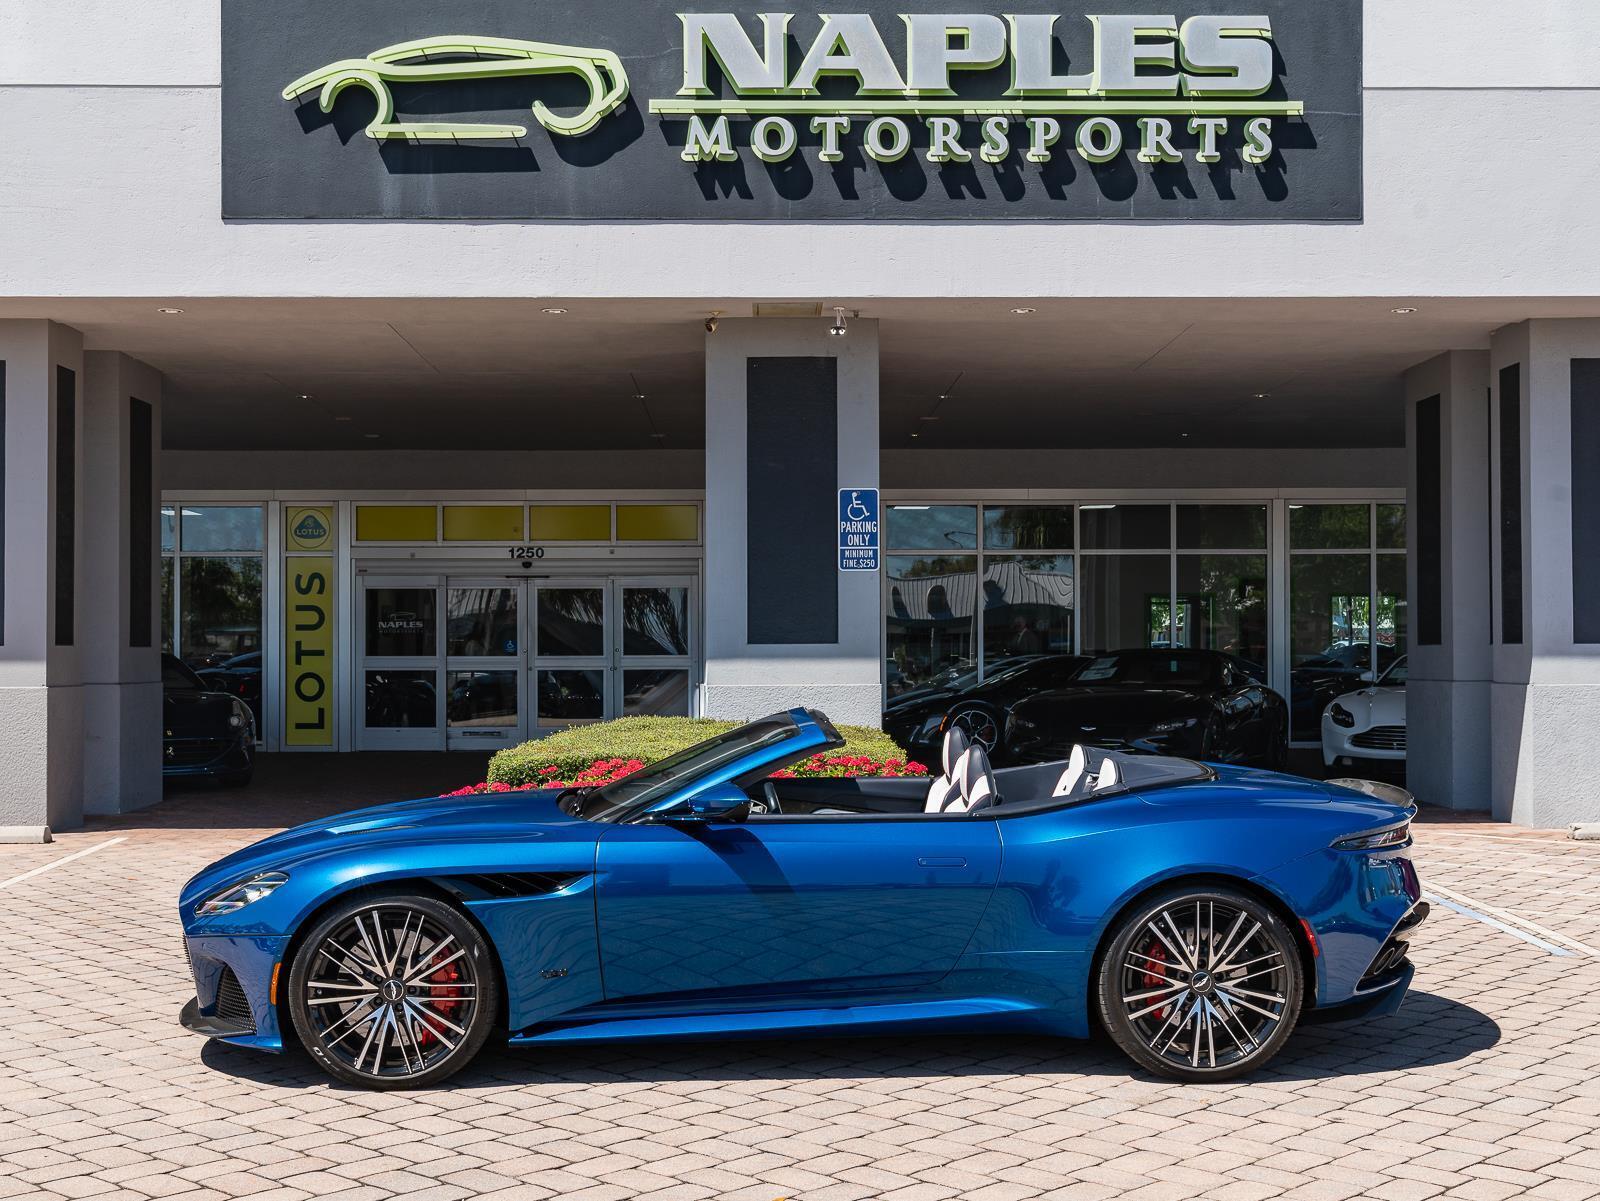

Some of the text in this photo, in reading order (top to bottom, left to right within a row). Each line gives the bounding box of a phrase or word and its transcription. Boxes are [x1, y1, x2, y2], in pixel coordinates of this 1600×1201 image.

[678, 13, 1273, 96] NAPLES
[682, 116, 1273, 163] MOTORSPORTS
[840, 521, 877, 533] PARKING
[847, 534, 870, 546] ONLY
[508, 547, 544, 558] 1250
[844, 549, 874, 558] MINIMUM
[843, 559, 875, 568] FINE $250
[294, 572, 326, 730] LOTUS
